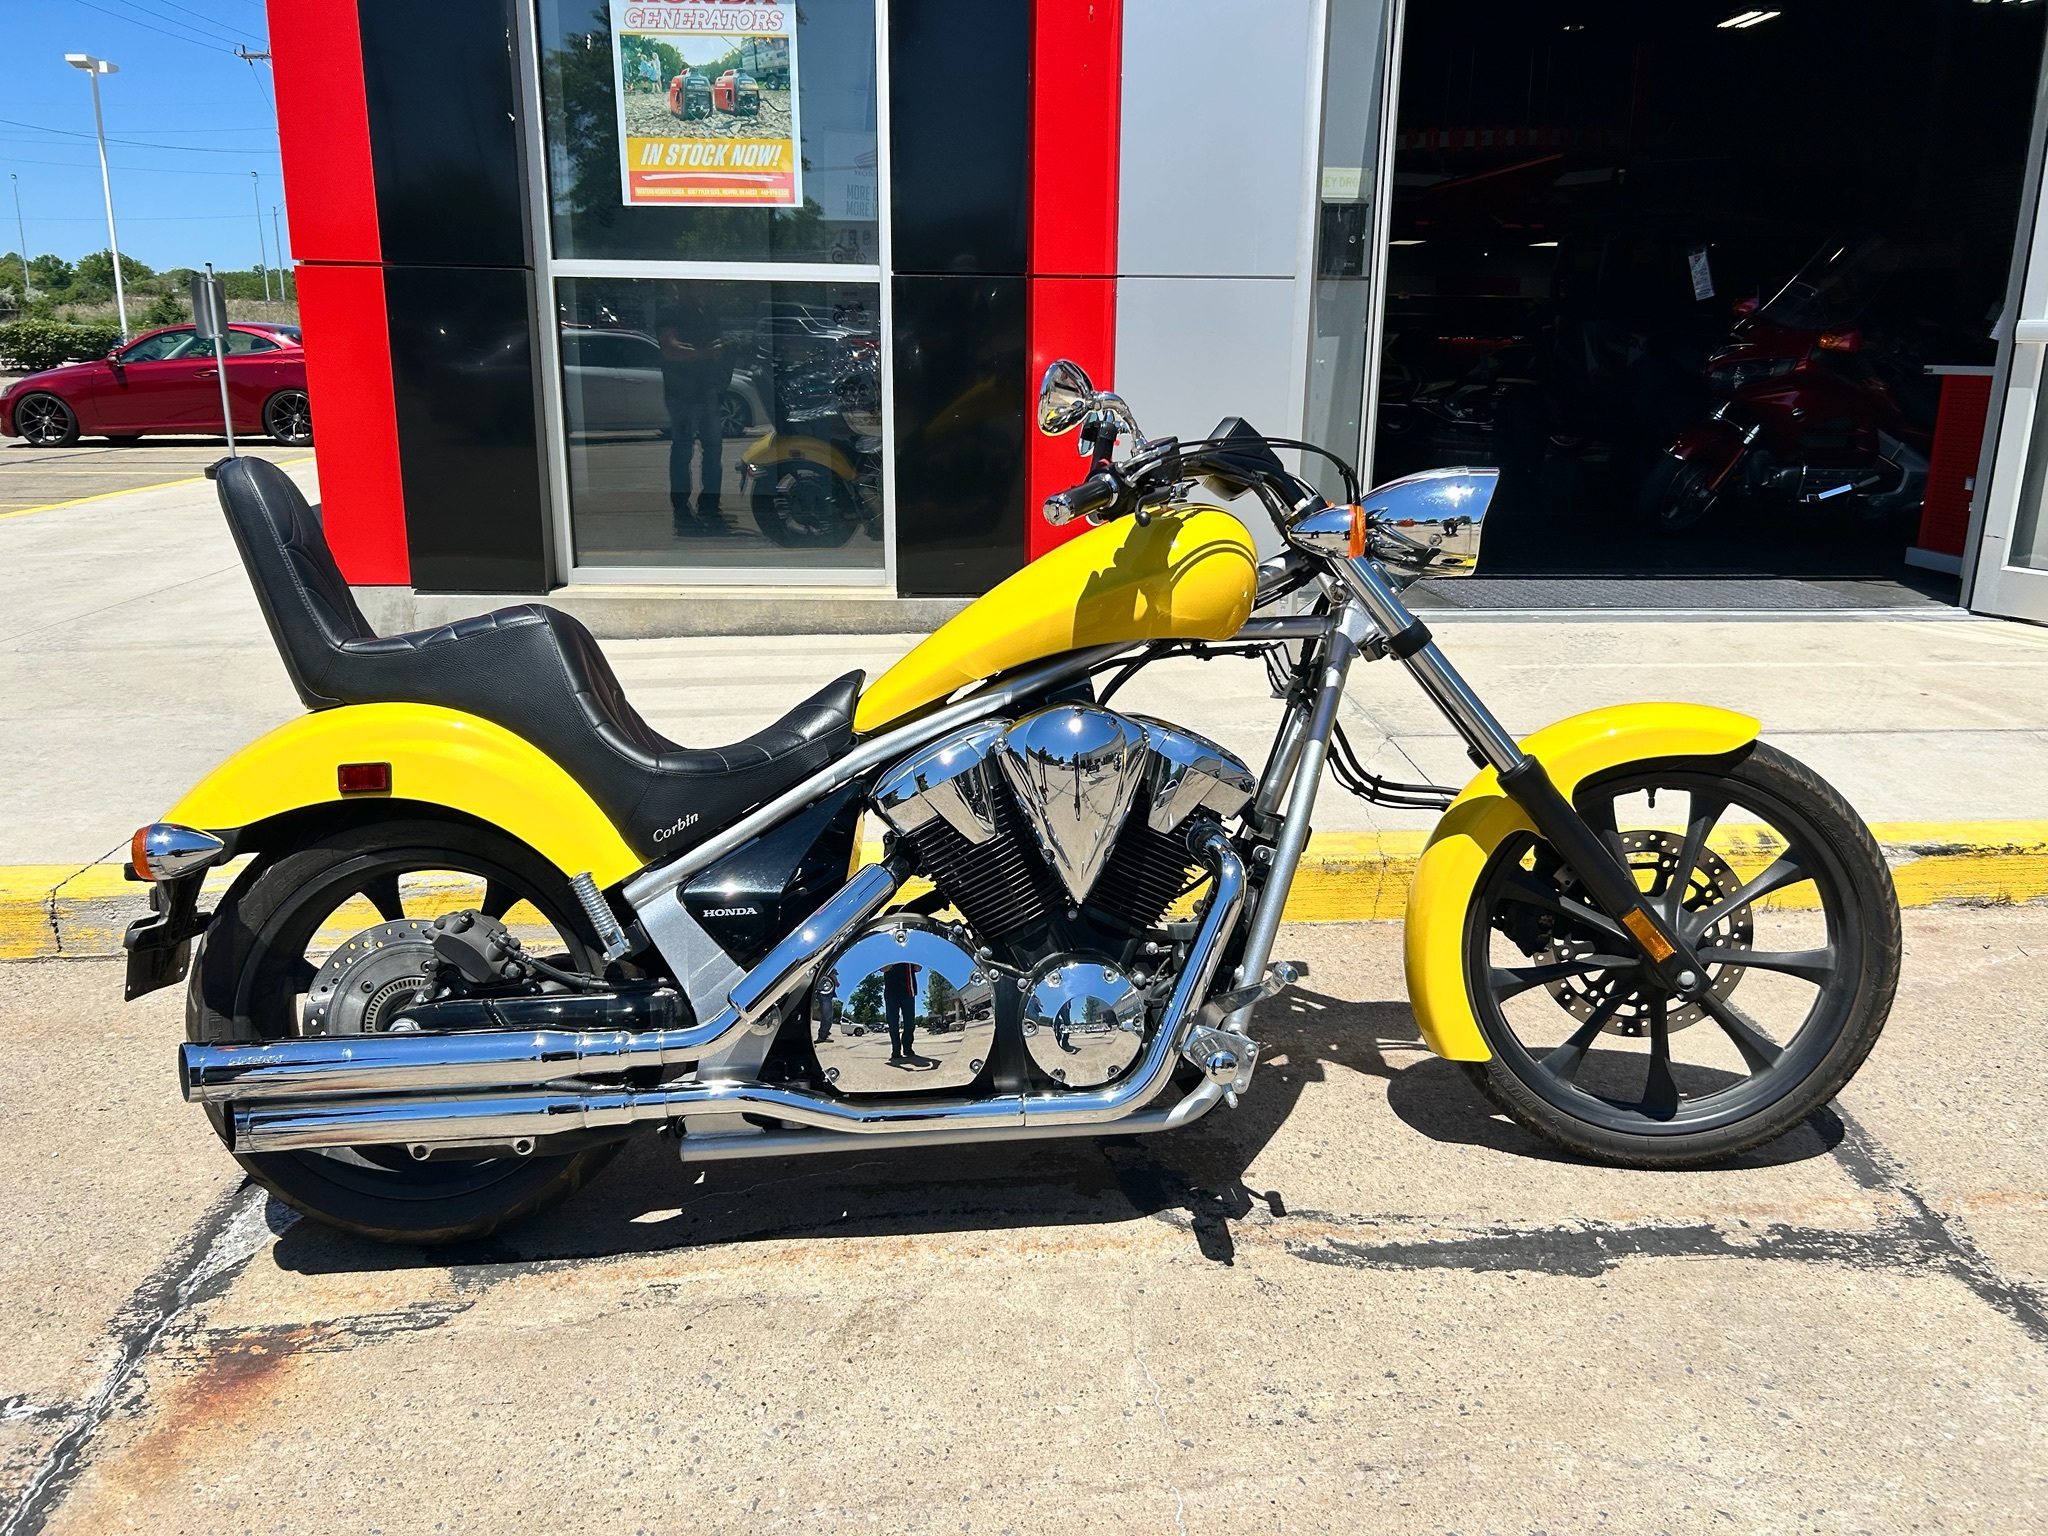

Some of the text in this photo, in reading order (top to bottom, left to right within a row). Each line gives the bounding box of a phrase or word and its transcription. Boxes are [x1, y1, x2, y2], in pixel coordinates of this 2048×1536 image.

[624, 7, 784, 31] GENERATORS
[1405, 123, 1612, 151] POWERHOU
[641, 143, 783, 167] IN STOCK NOW!
[854, 169, 875, 177] HON
[1323, 176, 1360, 188] EY DRO
[846, 183, 870, 201] MORE
[846, 200, 870, 217] MORE
[652, 812, 700, 843] Corbin
[702, 907, 758, 918] HONDA
